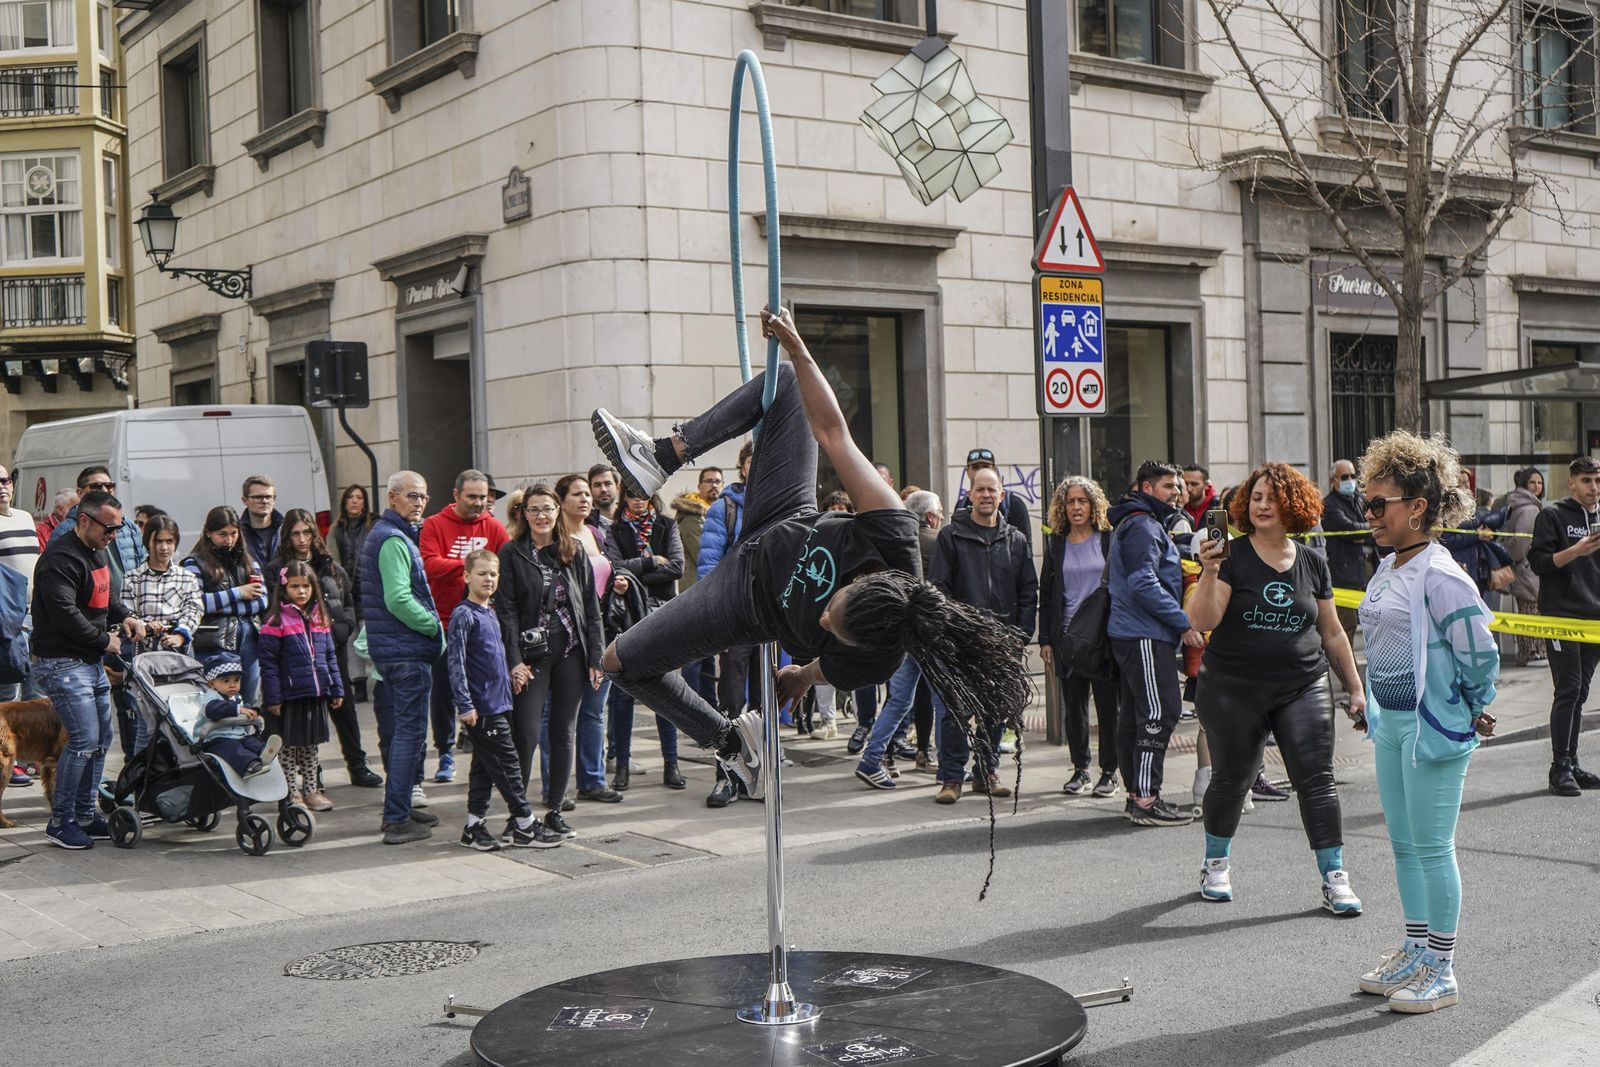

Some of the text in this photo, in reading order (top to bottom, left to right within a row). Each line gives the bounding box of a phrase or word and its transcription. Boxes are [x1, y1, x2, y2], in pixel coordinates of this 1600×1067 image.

[1059, 279, 1084, 290] ZONA
[1042, 291, 1101, 303] RESIDENCIAL
[1051, 378, 1068, 395] 20
[1242, 604, 1308, 626] charlot
[838, 1045, 910, 1062] charlot
